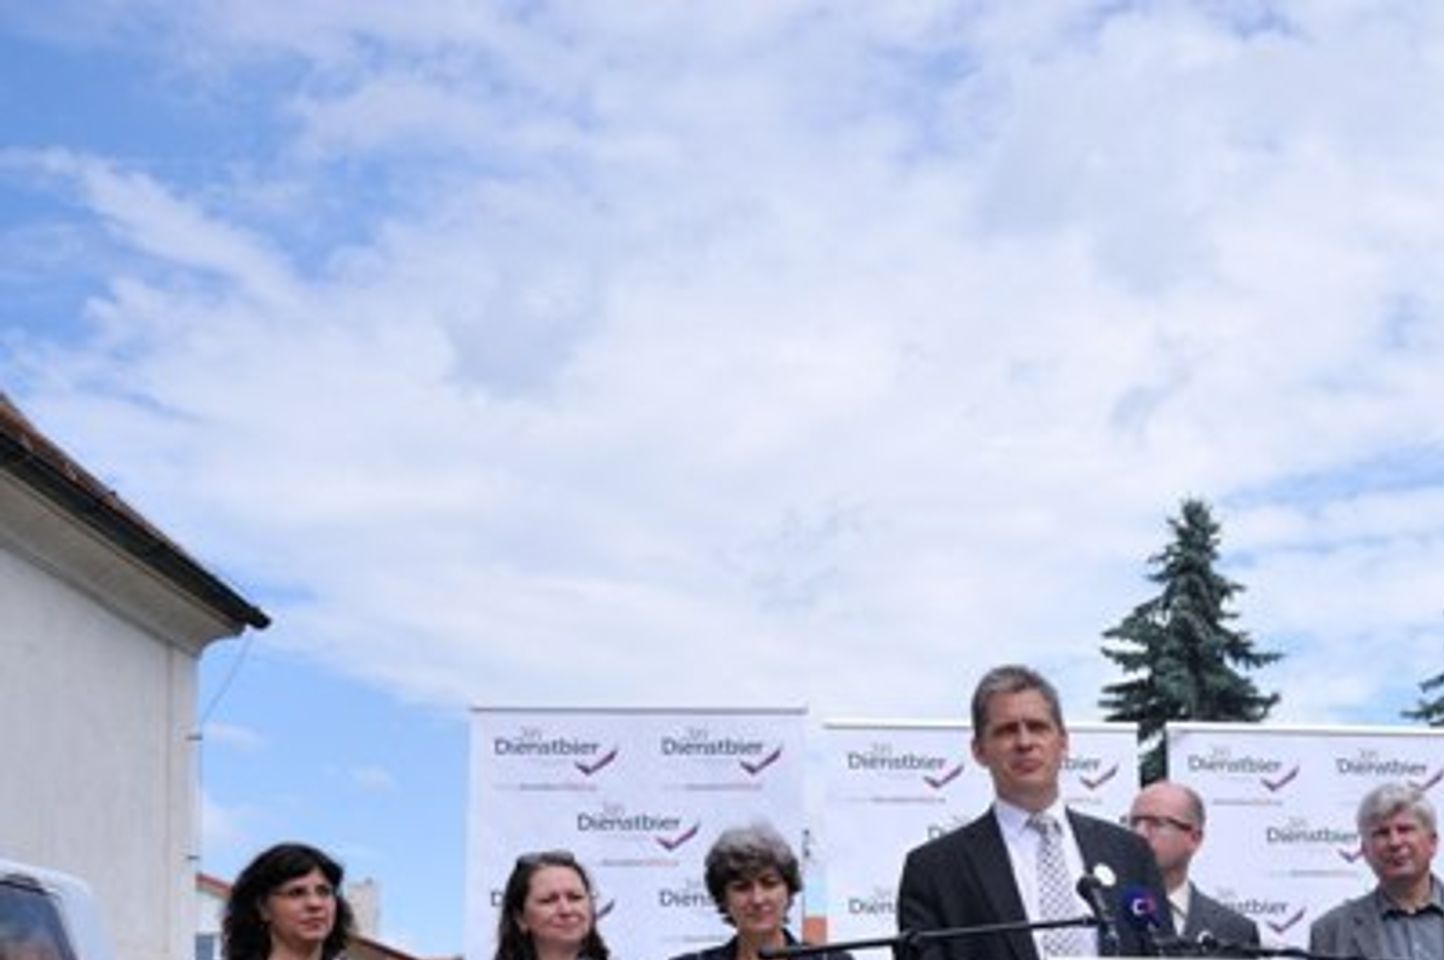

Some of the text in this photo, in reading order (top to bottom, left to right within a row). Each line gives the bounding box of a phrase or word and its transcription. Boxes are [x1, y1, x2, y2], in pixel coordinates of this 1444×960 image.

[494, 737, 598, 755] Dienstbier
[661, 737, 762, 755] Dienstbier
[848, 752, 946, 770] Dienstbier
[1188, 754, 1282, 773] Dienstbier
[1336, 758, 1427, 775] Dienstbier
[577, 812, 680, 831] Dienstbier
